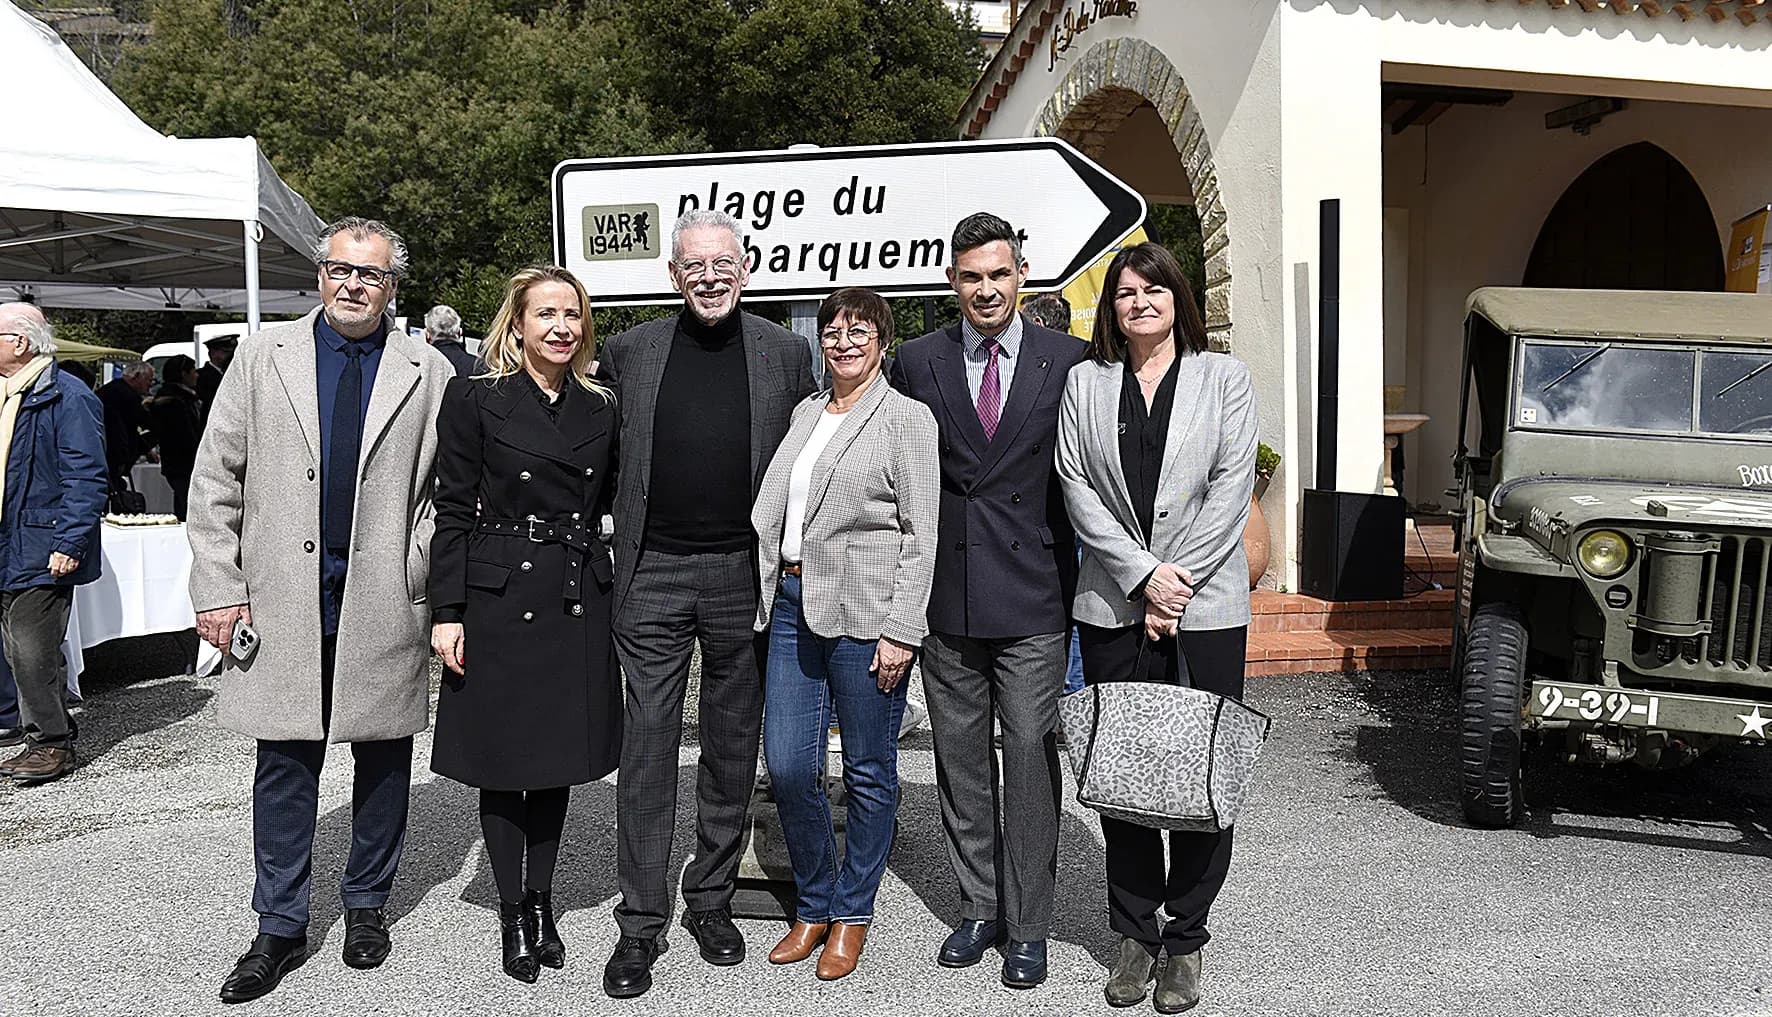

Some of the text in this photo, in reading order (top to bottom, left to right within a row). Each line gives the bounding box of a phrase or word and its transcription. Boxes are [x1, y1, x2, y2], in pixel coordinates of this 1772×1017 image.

[678, 176, 886, 230] plage du
[593, 213, 632, 235] VAR
[589, 233, 633, 256] 1944
